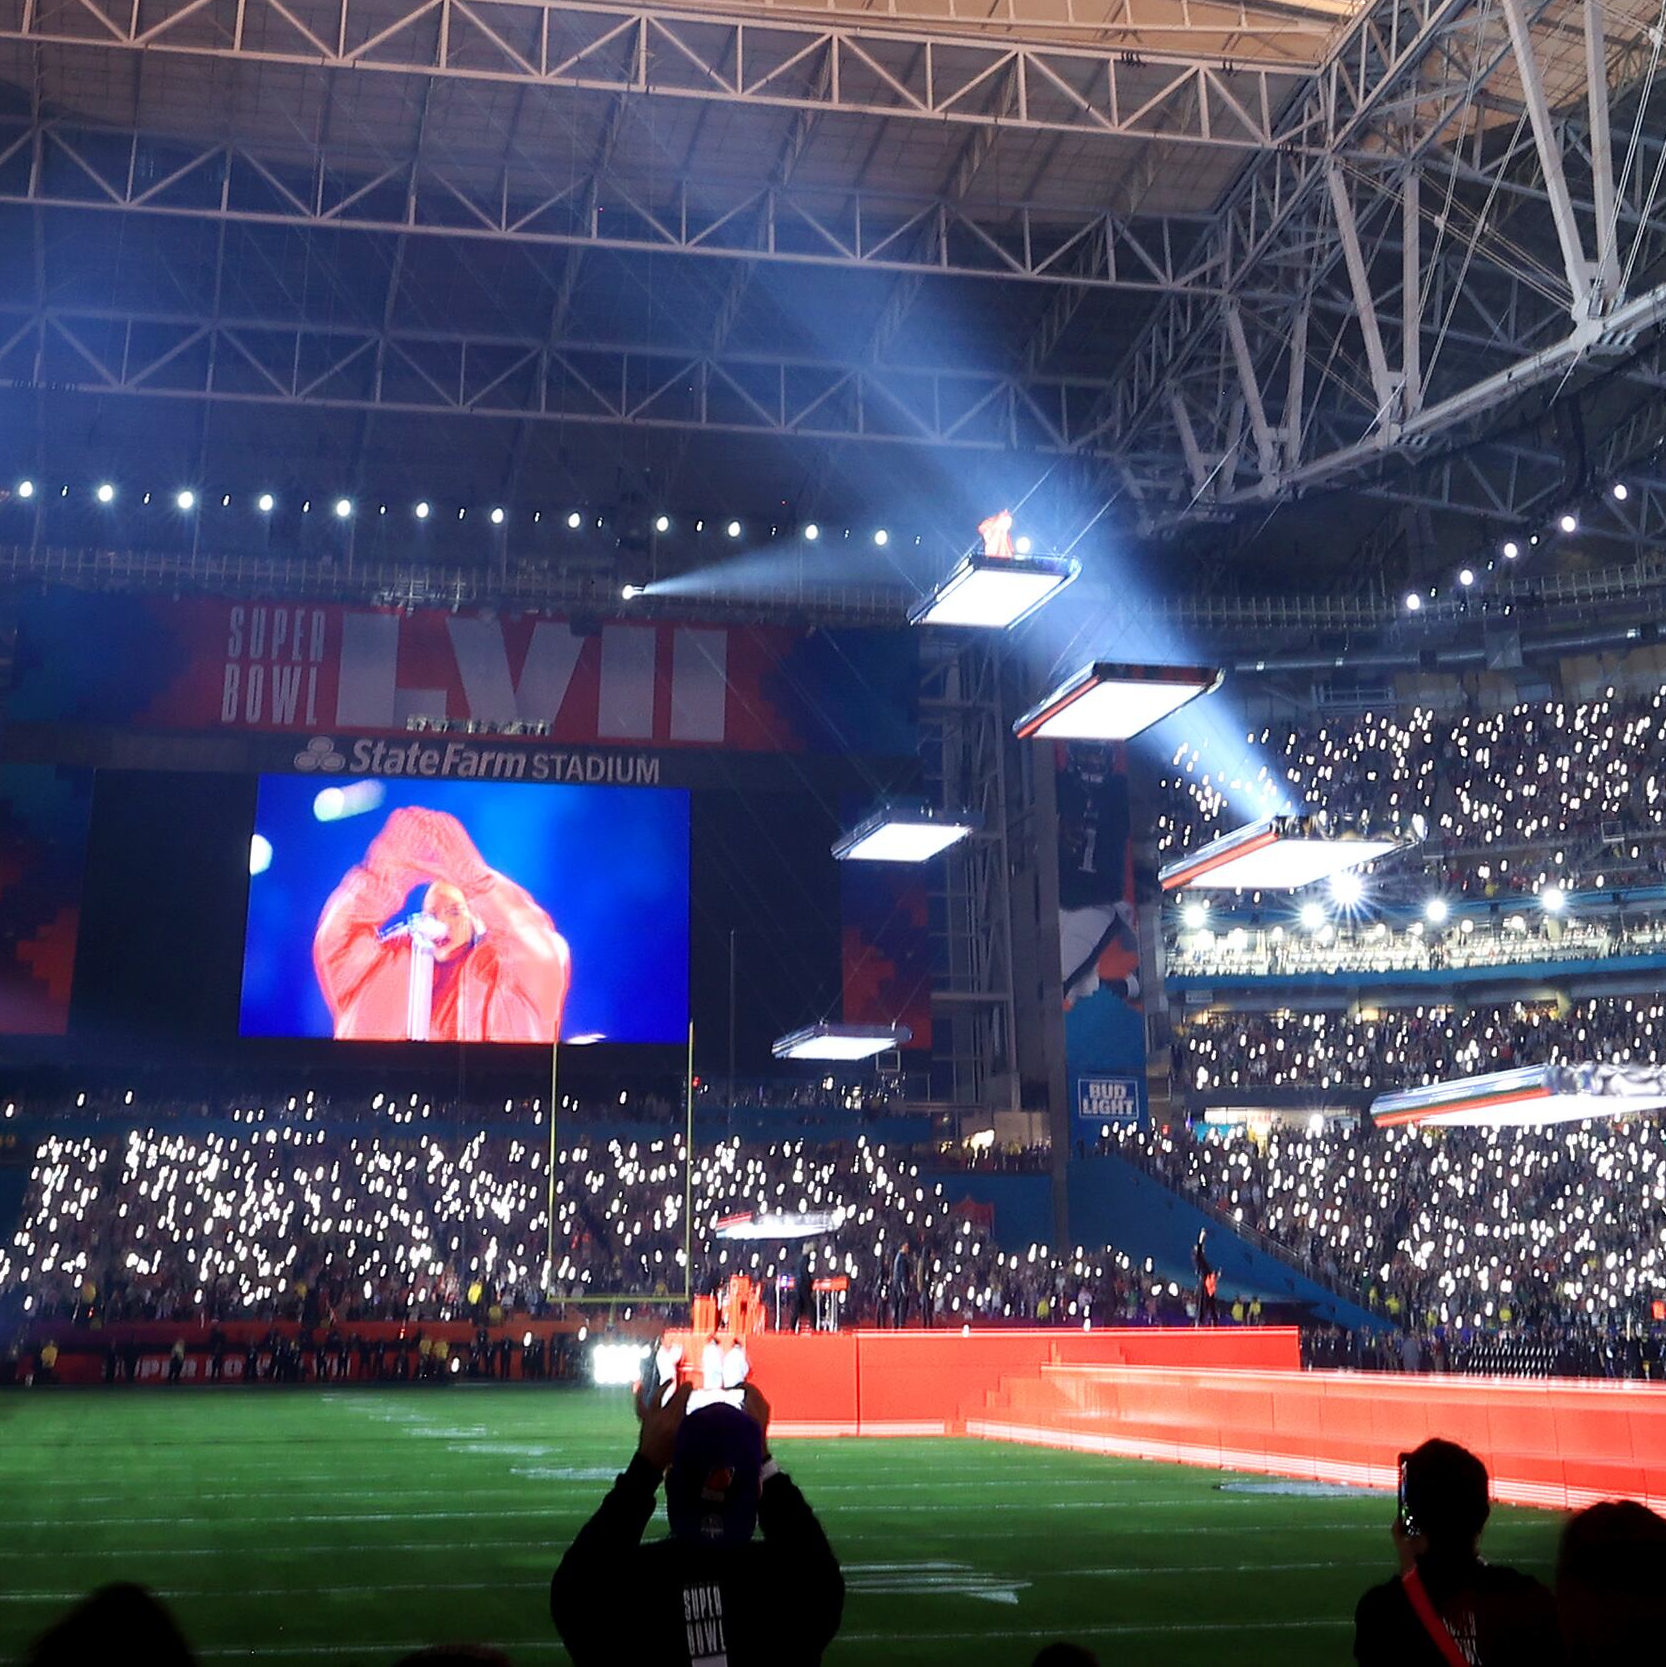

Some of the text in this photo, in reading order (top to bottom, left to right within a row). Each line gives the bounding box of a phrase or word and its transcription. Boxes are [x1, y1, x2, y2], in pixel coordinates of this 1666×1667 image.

[228, 605, 326, 662] SUPER
[221, 663, 317, 726] BOWL
[335, 611, 728, 743] LVII
[532, 754, 660, 785] STADIUM
[1083, 1098, 1134, 1116] LIGHT
[1088, 1082, 1128, 1099] BUD
[683, 1584, 723, 1622] SUPER
[686, 1617, 727, 1656] BOWL
